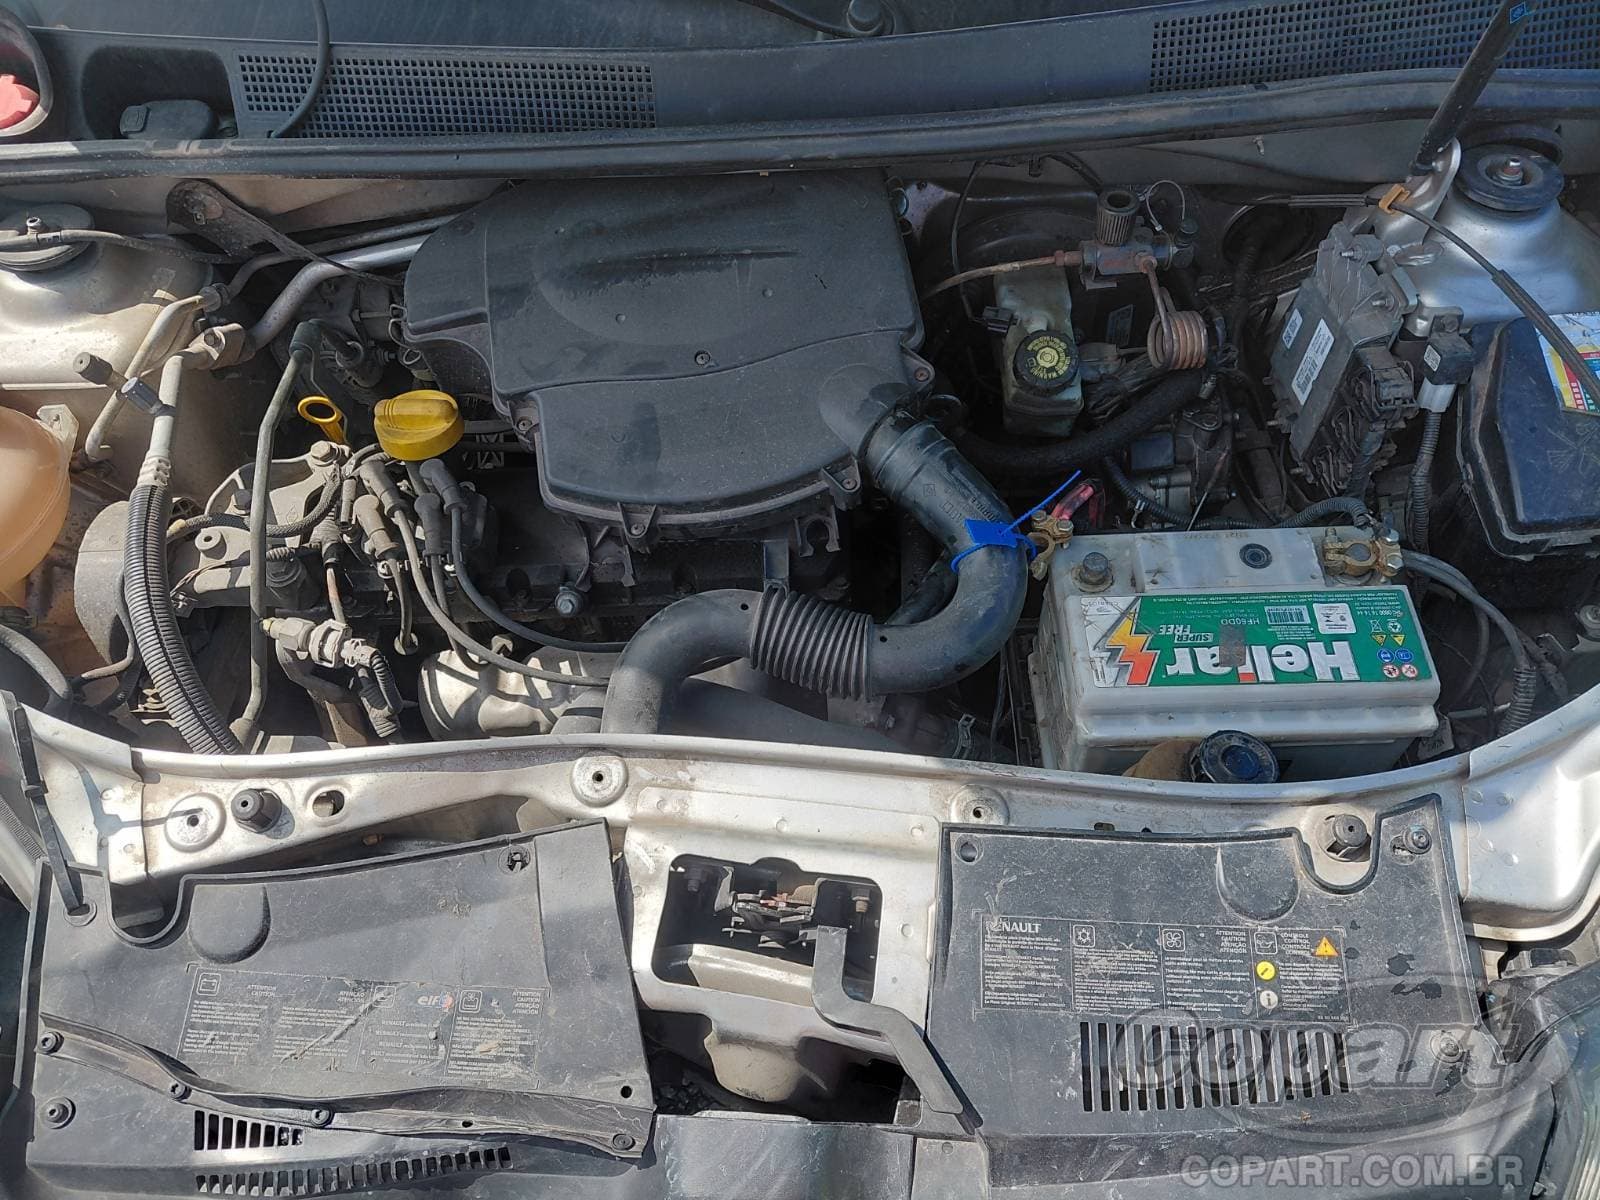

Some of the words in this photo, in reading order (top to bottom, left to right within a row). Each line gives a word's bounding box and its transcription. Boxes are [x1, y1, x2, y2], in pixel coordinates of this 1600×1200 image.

[1159, 624, 1192, 635] FREE
[1177, 633, 1211, 642] SUPER
[1166, 640, 1361, 683] Heliar
[417, 995, 440, 1005] elf
